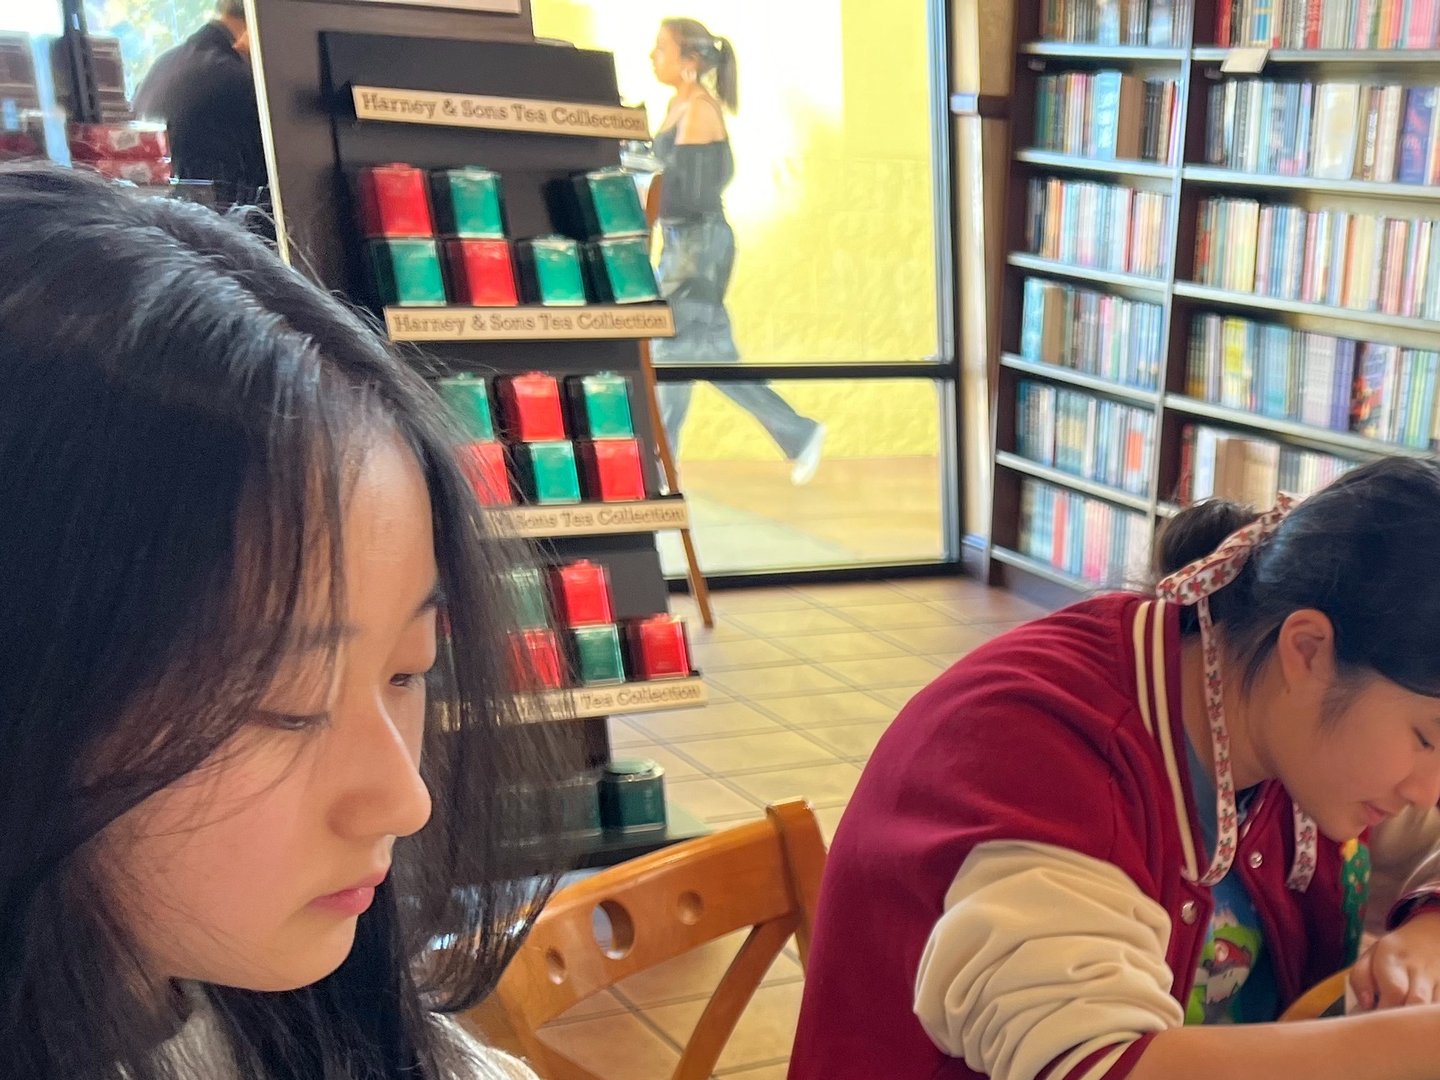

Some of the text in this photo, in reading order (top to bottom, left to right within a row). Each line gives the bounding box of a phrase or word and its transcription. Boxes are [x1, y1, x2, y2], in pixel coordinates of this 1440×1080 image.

[361, 92, 646, 131] Harney & Sons Tea Collection
[392, 311, 667, 336] Harney & Sons Tea Collection
[561, 511, 593, 528] Tea
[597, 507, 685, 526] Collection
[580, 692, 613, 709] Tea
[616, 684, 701, 706] Collection
